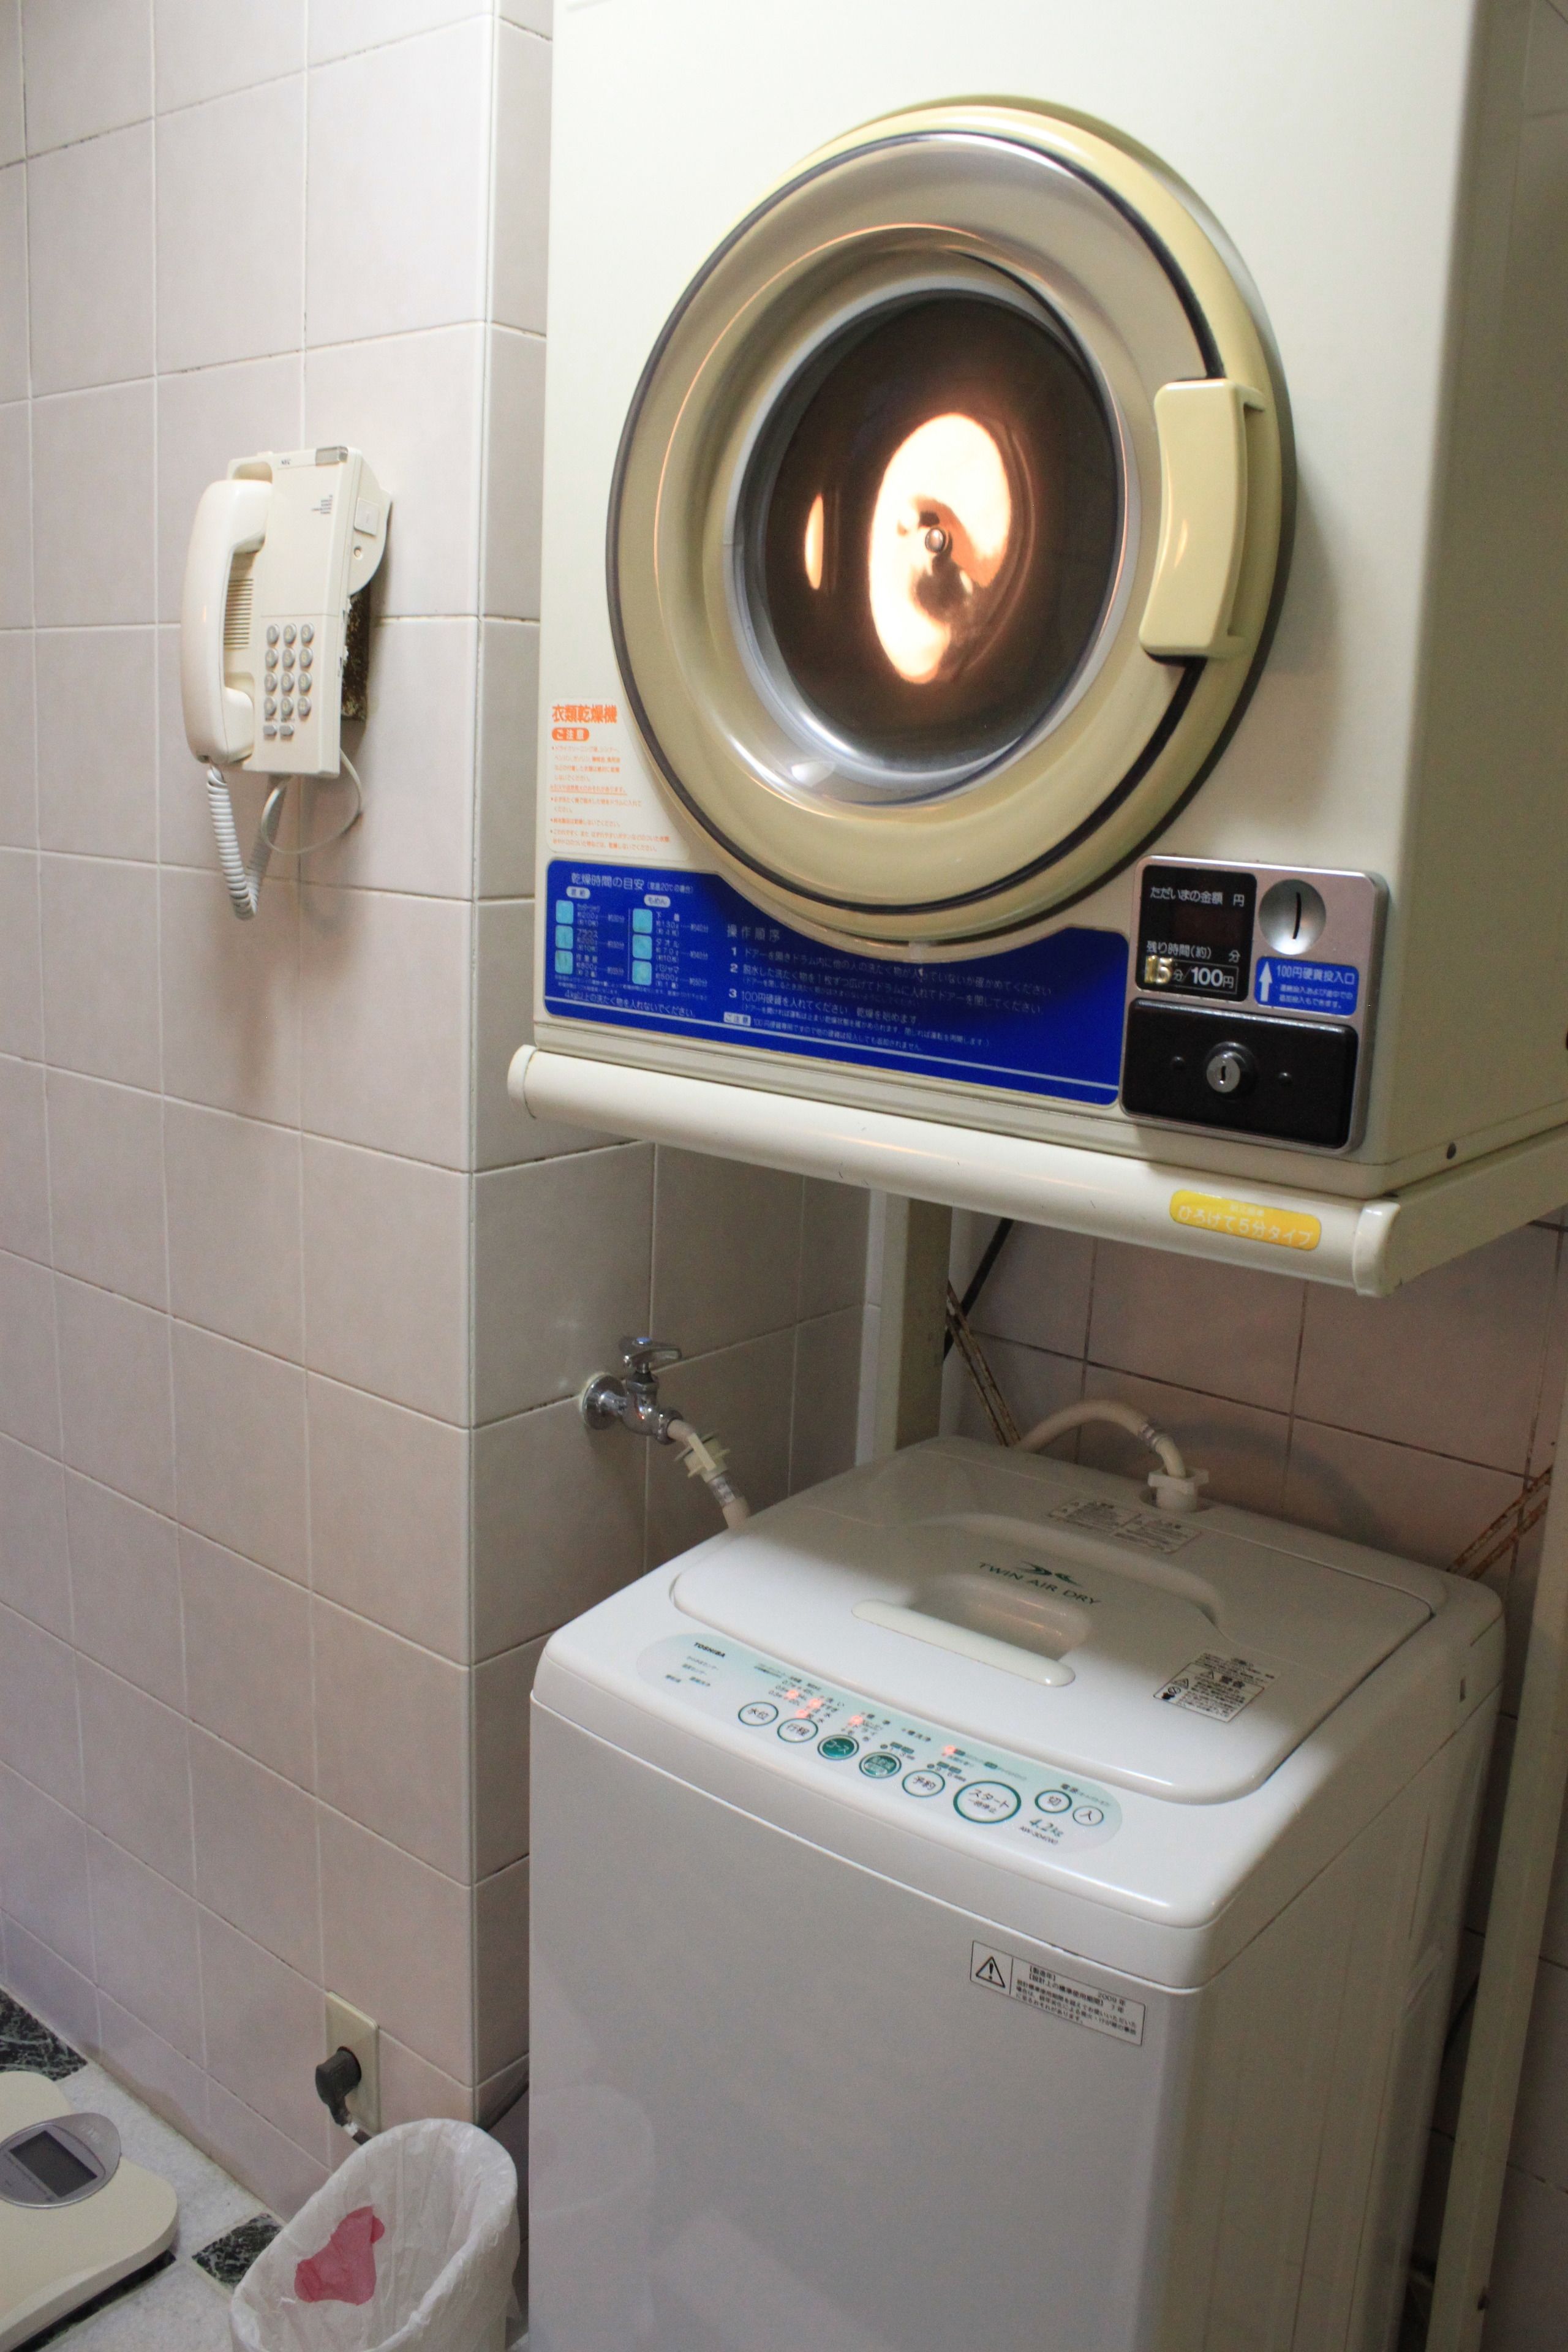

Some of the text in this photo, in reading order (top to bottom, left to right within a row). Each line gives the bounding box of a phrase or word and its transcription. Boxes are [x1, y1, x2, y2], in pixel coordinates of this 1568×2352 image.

[552, 704, 617, 724] 衣類乾燥機
[571, 872, 644, 891] 乾燥時間の目安
[1150, 886, 1245, 908] ただいまの金額 円
[727, 924, 780, 943] 操作順序
[731, 947, 737, 956] 1
[1228, 949, 1241, 963] 分
[729, 963, 739, 973] 2
[1276, 963, 1355, 986] 100円硬貨投入口
[729, 988, 737, 998] 3
[979, 1562, 1102, 1605] TWIN AIR DRY
[694, 1642, 726, 1658] TOSHIBA
[968, 1787, 1010, 1809] スタート
[1047, 1796, 1061, 1807] 切
[1080, 1811, 1095, 1822] 入
